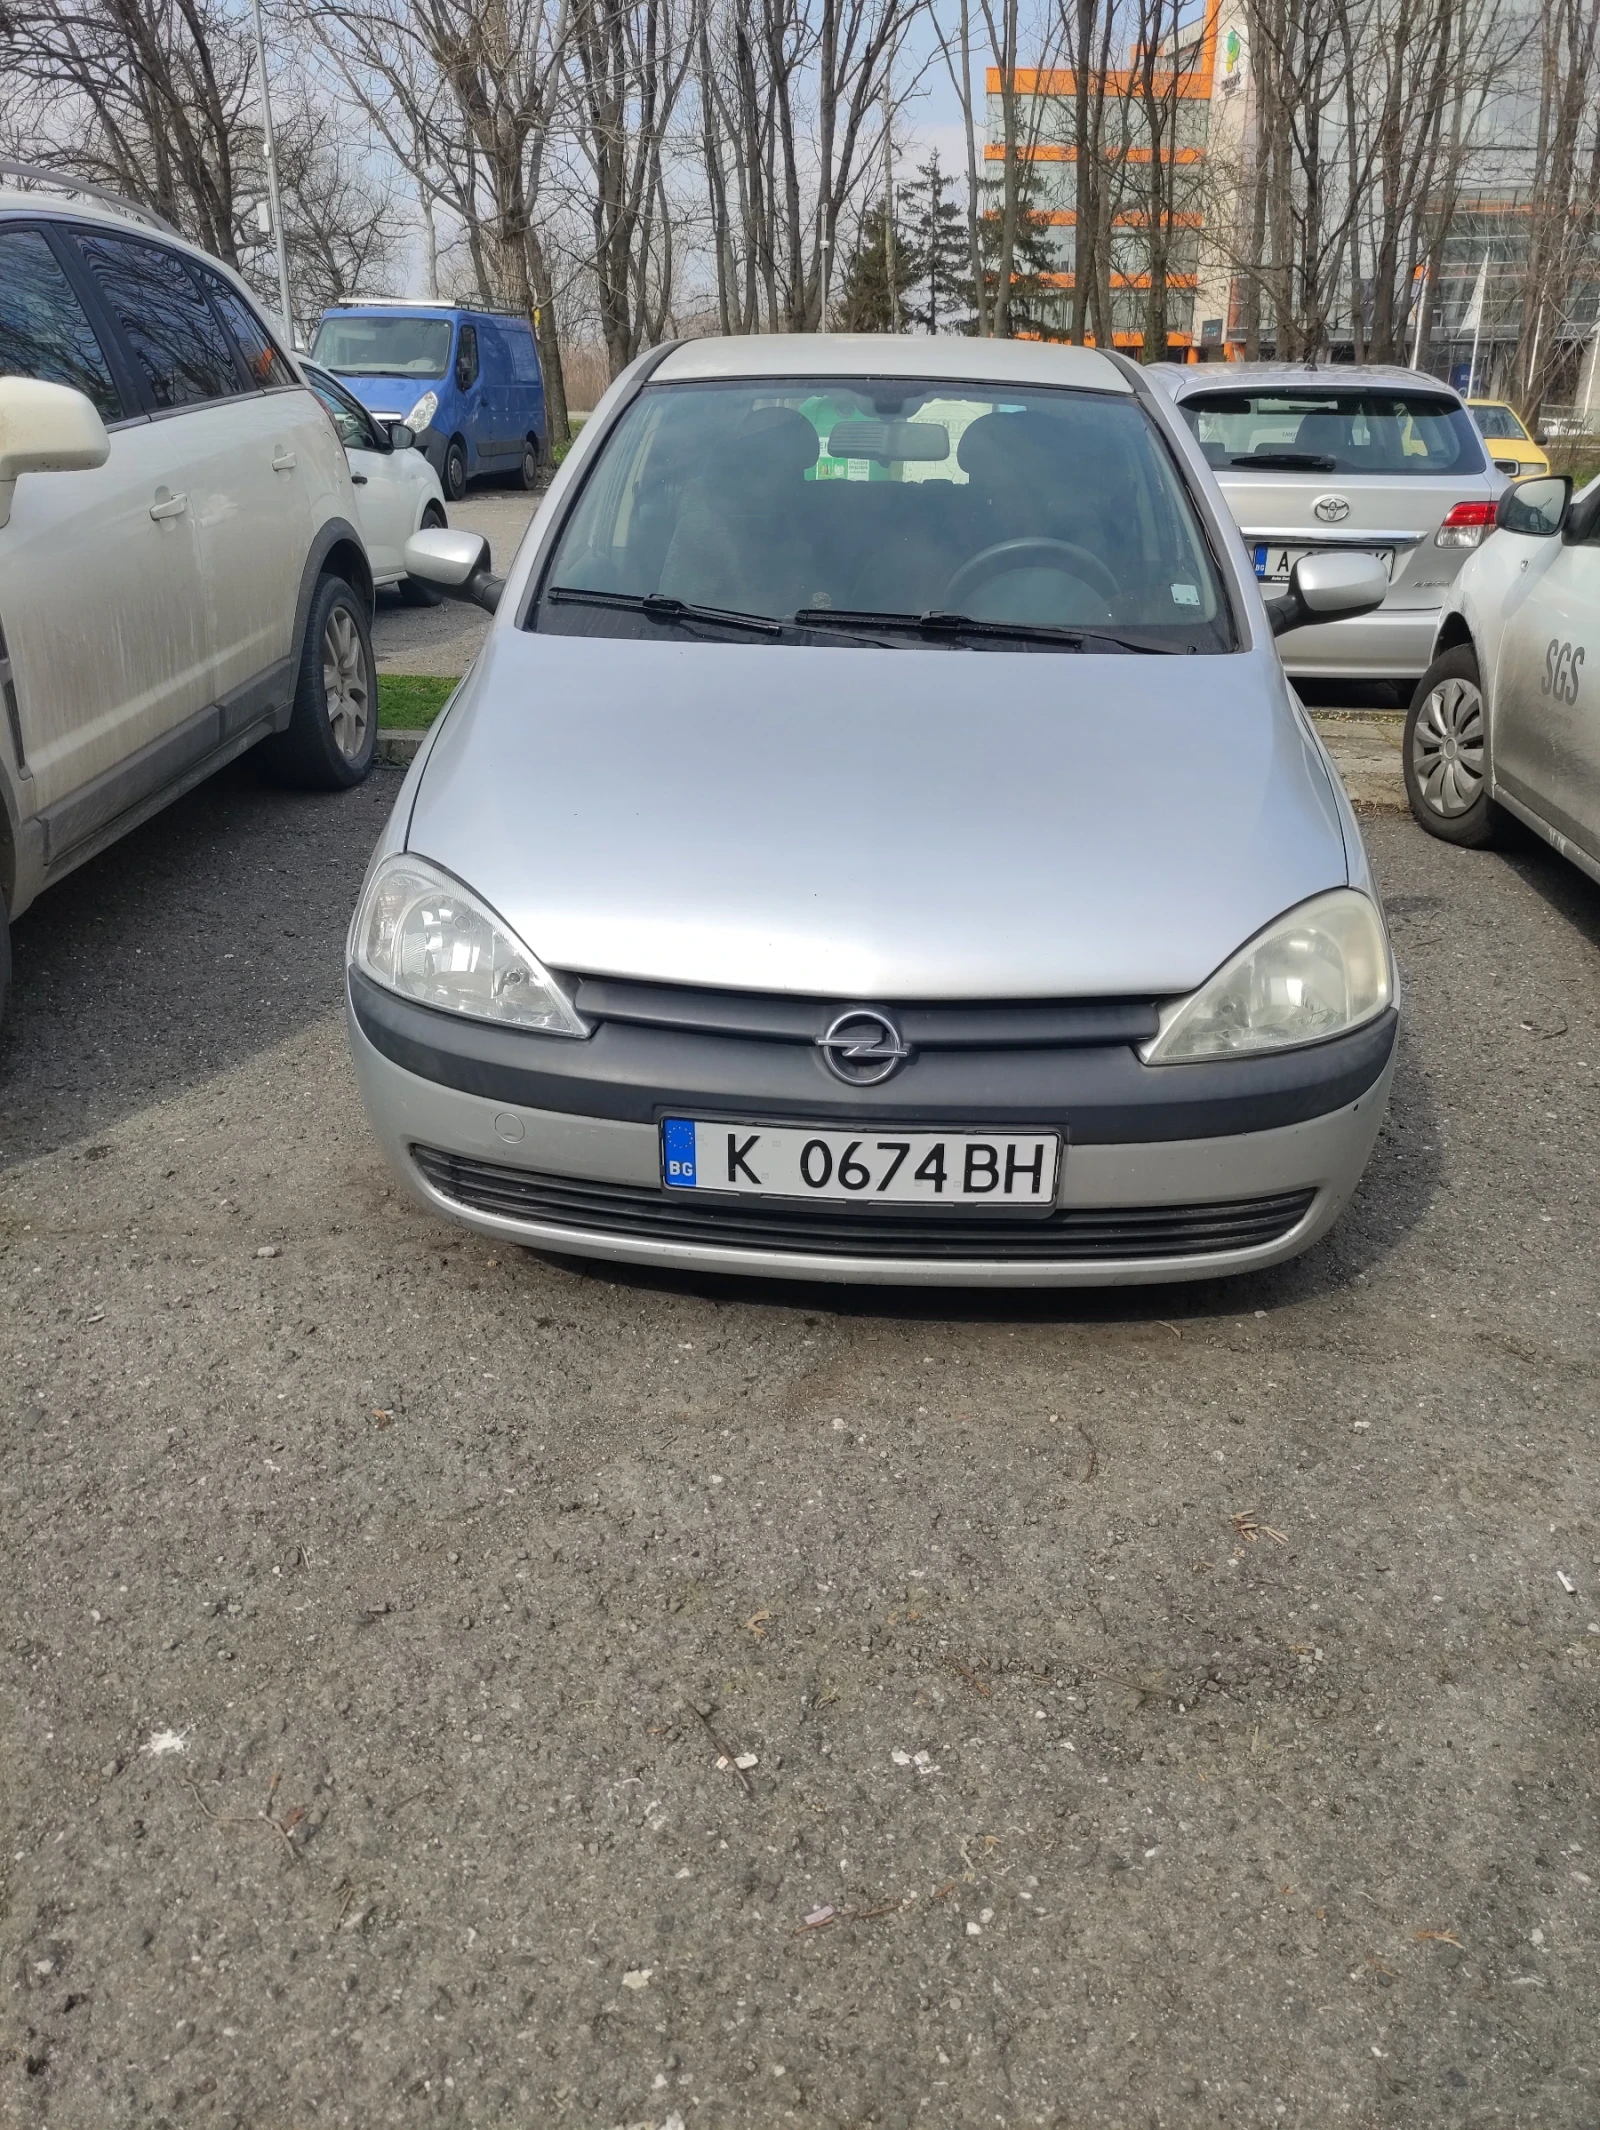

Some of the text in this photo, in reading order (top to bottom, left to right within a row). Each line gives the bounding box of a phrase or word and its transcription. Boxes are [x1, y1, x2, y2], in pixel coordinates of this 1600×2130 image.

[1276, 551, 1290, 572] A
[1540, 638, 1585, 706] SGS
[669, 1160, 693, 1177] BG
[727, 1133, 1044, 1194] K 0674BH
